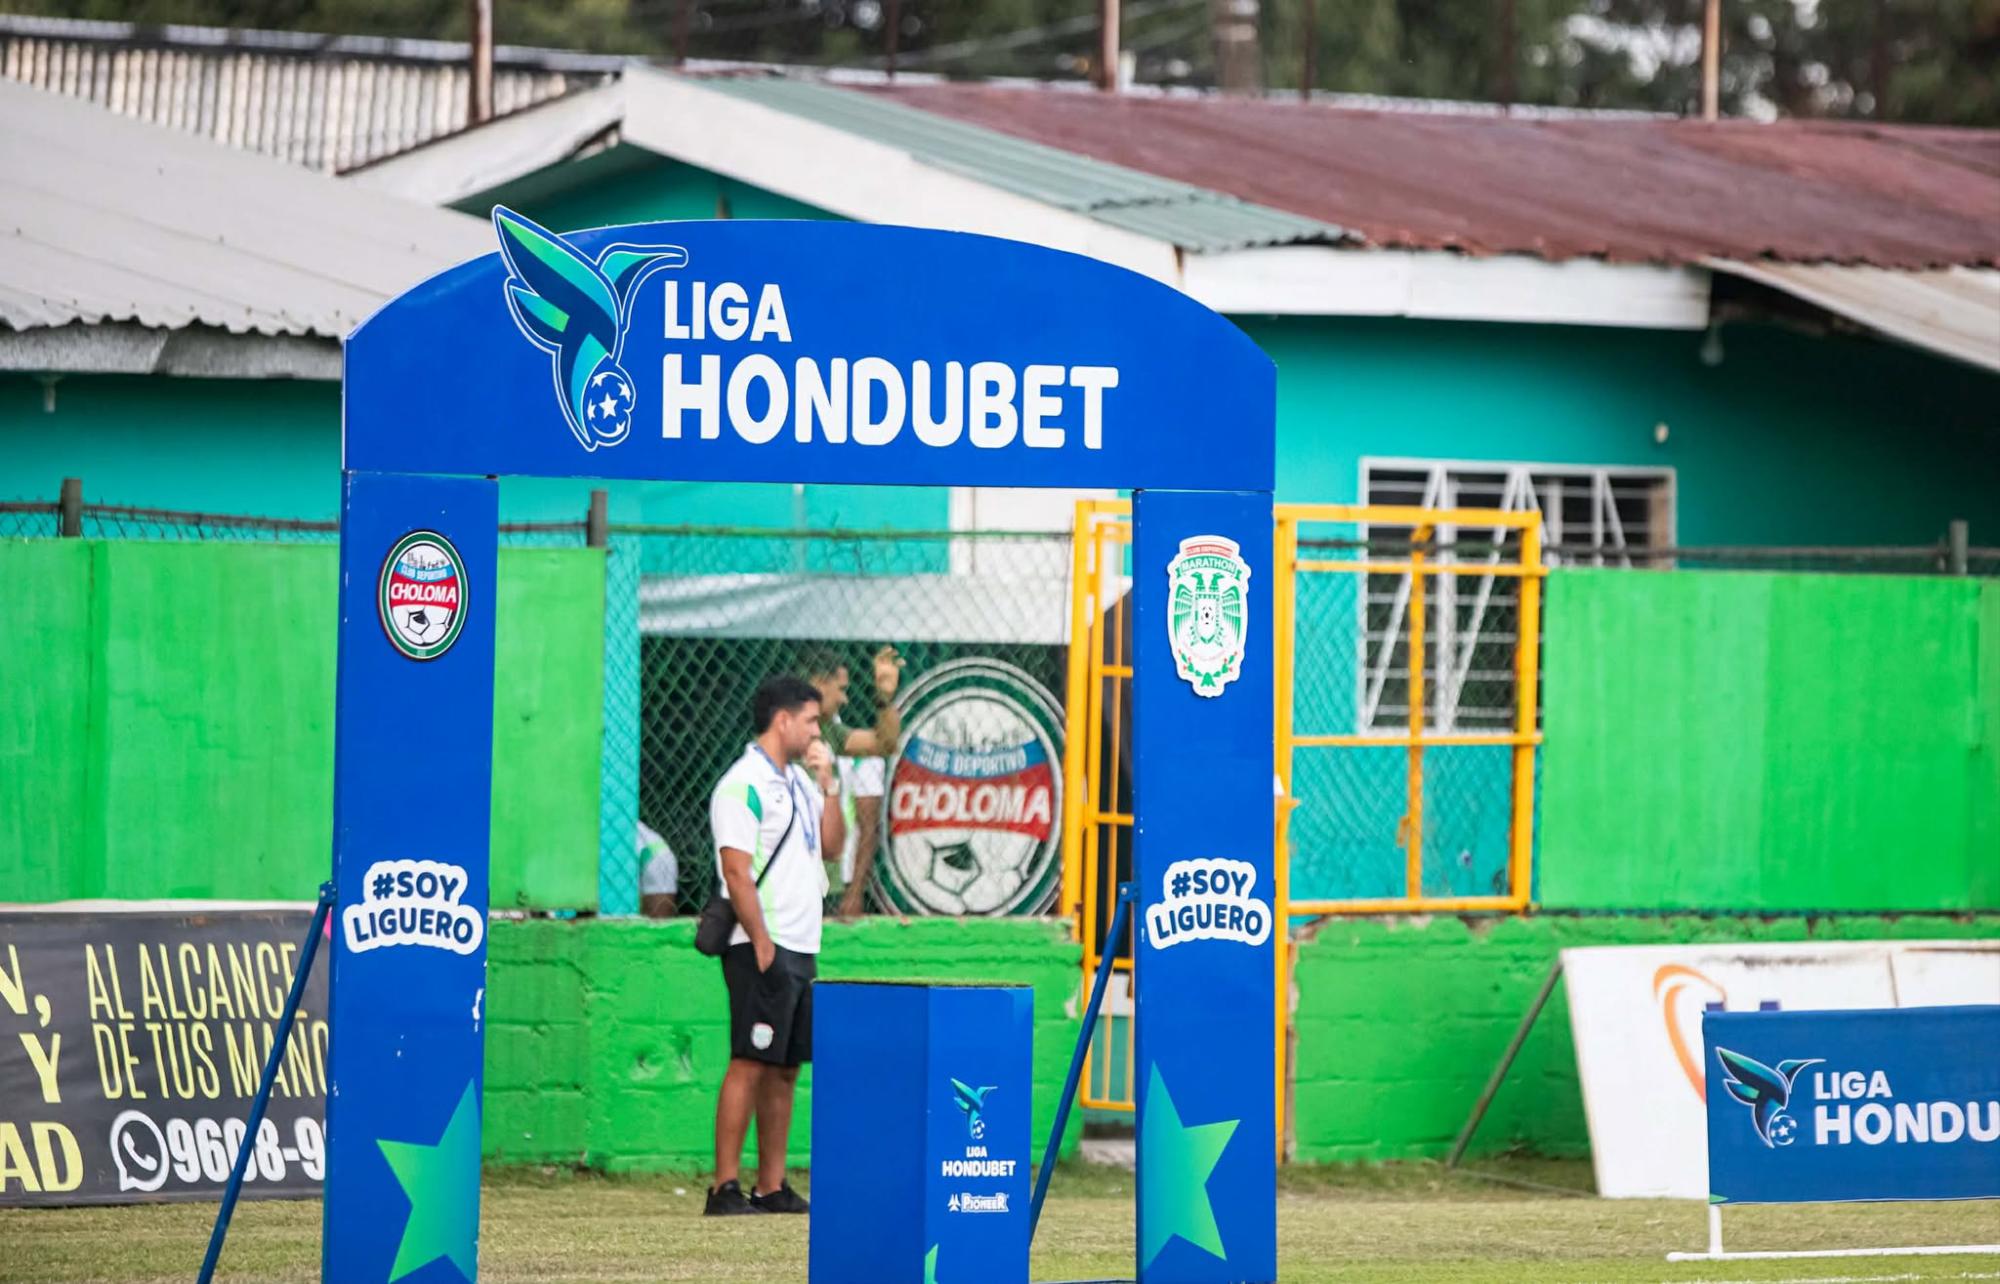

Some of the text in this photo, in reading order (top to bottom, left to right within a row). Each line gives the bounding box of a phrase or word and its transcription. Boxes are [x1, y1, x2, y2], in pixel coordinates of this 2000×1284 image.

[664, 280, 793, 342] LIGA
[662, 353, 1119, 449] HONDUBET
[1180, 556, 1237, 573] MARATHON
[390, 582, 457, 603] CHOLOMA
[892, 781, 1051, 825] CHOLOMA
[372, 871, 459, 902] #SOY
[1171, 868, 1249, 899] #SOY
[353, 907, 473, 944] LIGUERO
[1154, 903, 1263, 940] LIGUERO
[86, 942, 308, 1020] AL ALCANCE
[18, 1033, 62, 1103] Y
[92, 1022, 147, 1099] DE
[145, 1022, 220, 1099] TUS
[1814, 1070, 1893, 1100] LIGA
[1814, 1101, 2000, 1145] HONDU
[166, 1116, 328, 1183] 9608-9
[966, 1146, 988, 1158] LIGA
[941, 1160, 1017, 1177] HONDUBET
